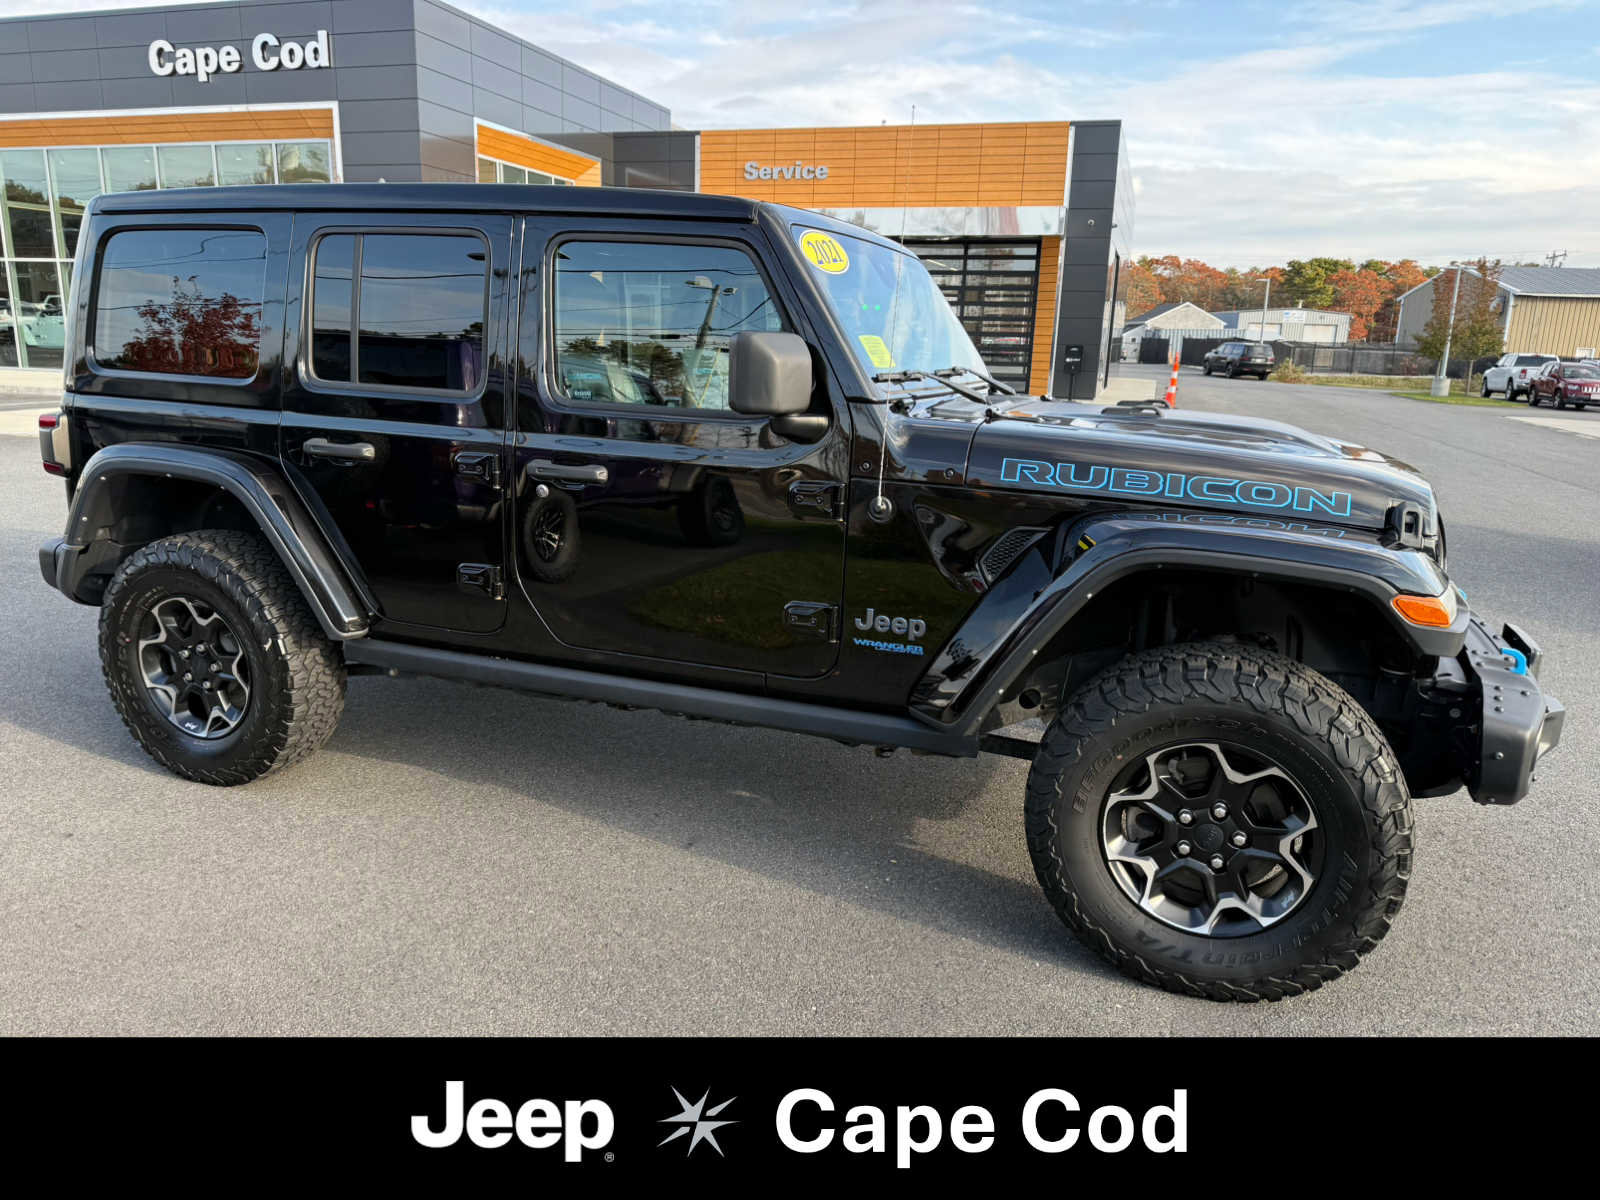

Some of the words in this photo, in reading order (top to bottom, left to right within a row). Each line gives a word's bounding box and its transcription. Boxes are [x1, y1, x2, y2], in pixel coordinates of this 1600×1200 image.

[148, 39, 243, 82] Cape
[252, 30, 330, 71] Cod
[744, 161, 829, 180] Service
[807, 240, 844, 265] 2021
[1001, 458, 1352, 517] RUBICON
[855, 608, 927, 641] Jeep
